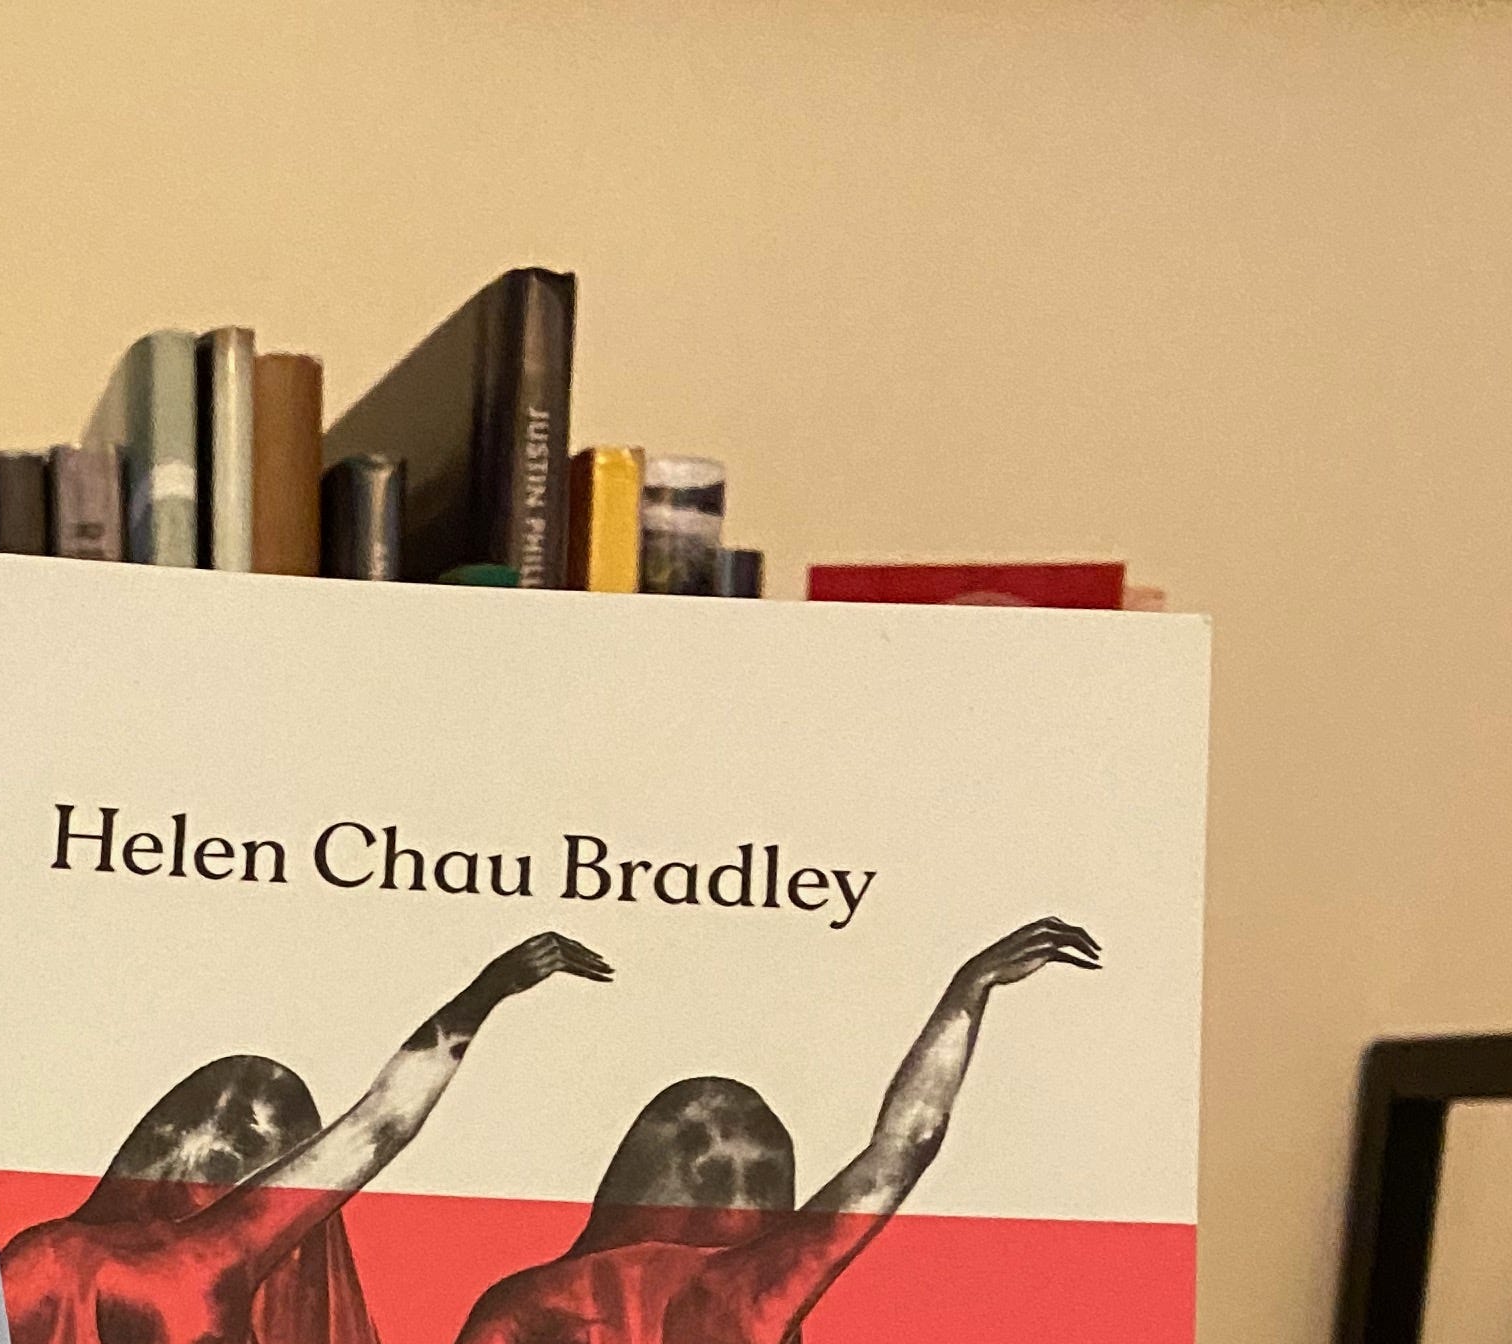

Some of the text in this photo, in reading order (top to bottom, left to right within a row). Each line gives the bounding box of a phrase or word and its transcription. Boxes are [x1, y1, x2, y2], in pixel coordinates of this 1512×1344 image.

[51, 803, 878, 931] Helen Chau Bradley
